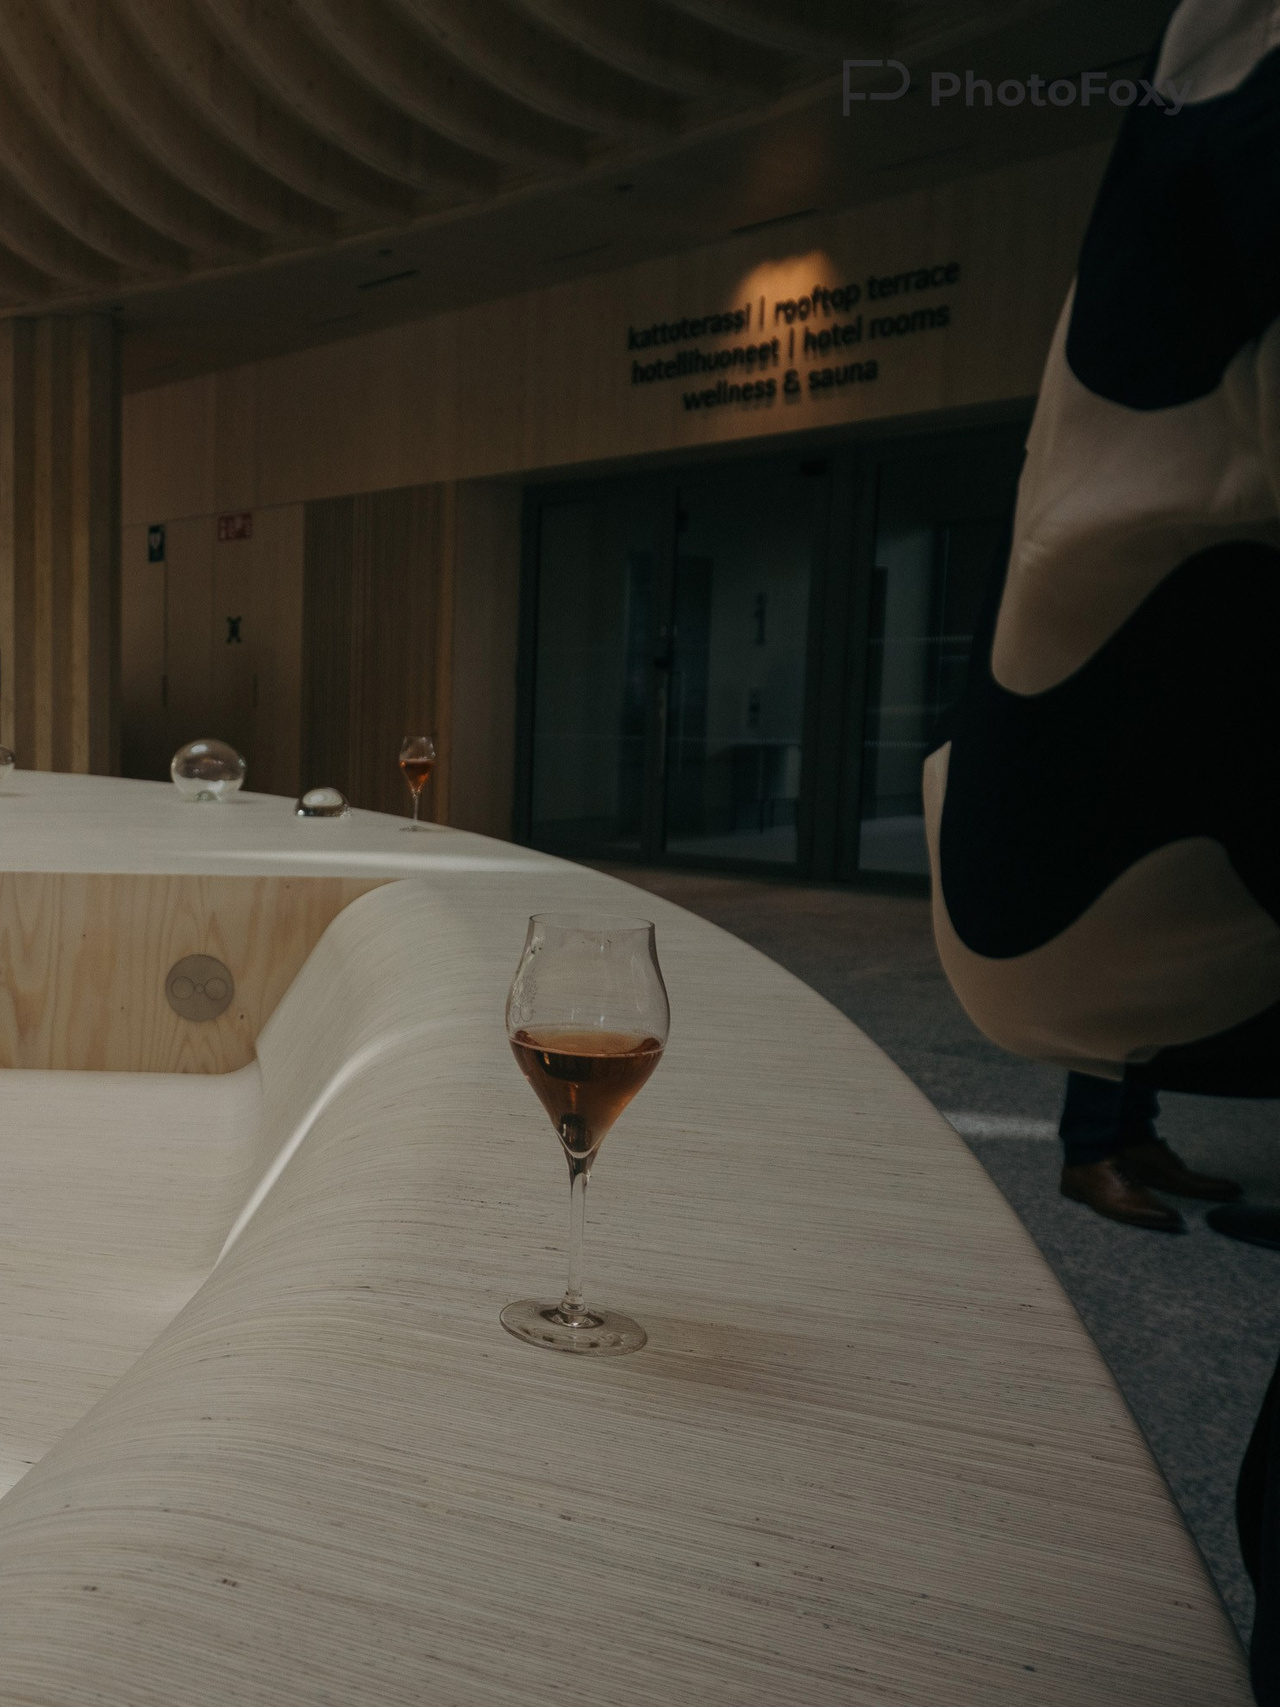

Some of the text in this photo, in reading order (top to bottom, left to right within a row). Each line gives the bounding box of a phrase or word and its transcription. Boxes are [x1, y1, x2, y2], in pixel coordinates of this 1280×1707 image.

[629, 303, 751, 349] kattoterassi
[775, 285, 859, 323] rooftop
[867, 262, 959, 300] terrace
[632, 338, 779, 384] hotellihuoneet
[804, 315, 862, 355] hotel
[870, 305, 949, 340] rooms
[682, 360, 878, 411] wellness & sauna
